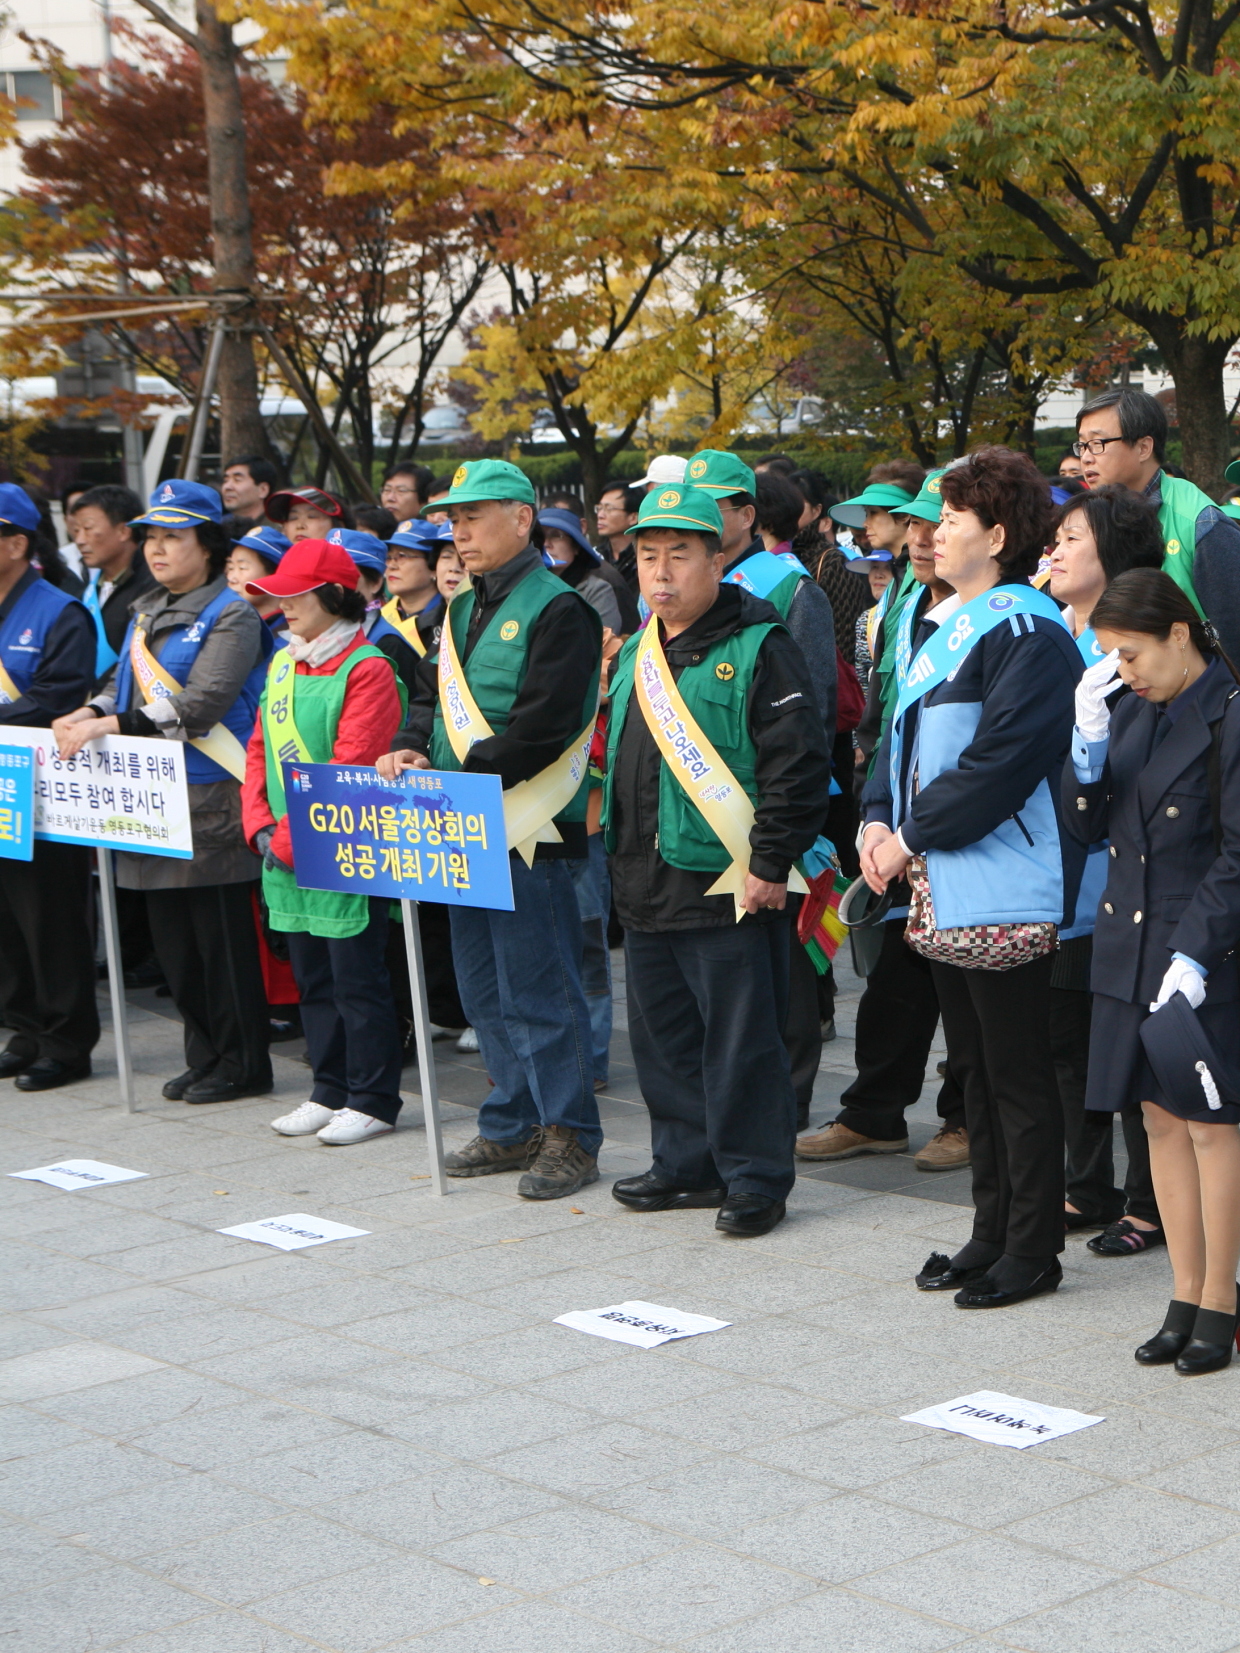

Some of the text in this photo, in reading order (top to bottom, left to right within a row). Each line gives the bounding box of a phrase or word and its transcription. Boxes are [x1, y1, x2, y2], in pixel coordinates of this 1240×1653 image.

[741, 581, 754, 592] G20
[97, 751, 141, 779] 개최를
[147, 755, 176, 783] 위해
[408, 776, 416, 788] 새
[417, 776, 443, 790] 영등포
[35, 780, 165, 817] 리모두 참여 합시다
[309, 803, 487, 849] G20 서울정상회의
[335, 843, 471, 889] 성공 개최 기원
[948, 1404, 1052, 1435] 녹색어머니
